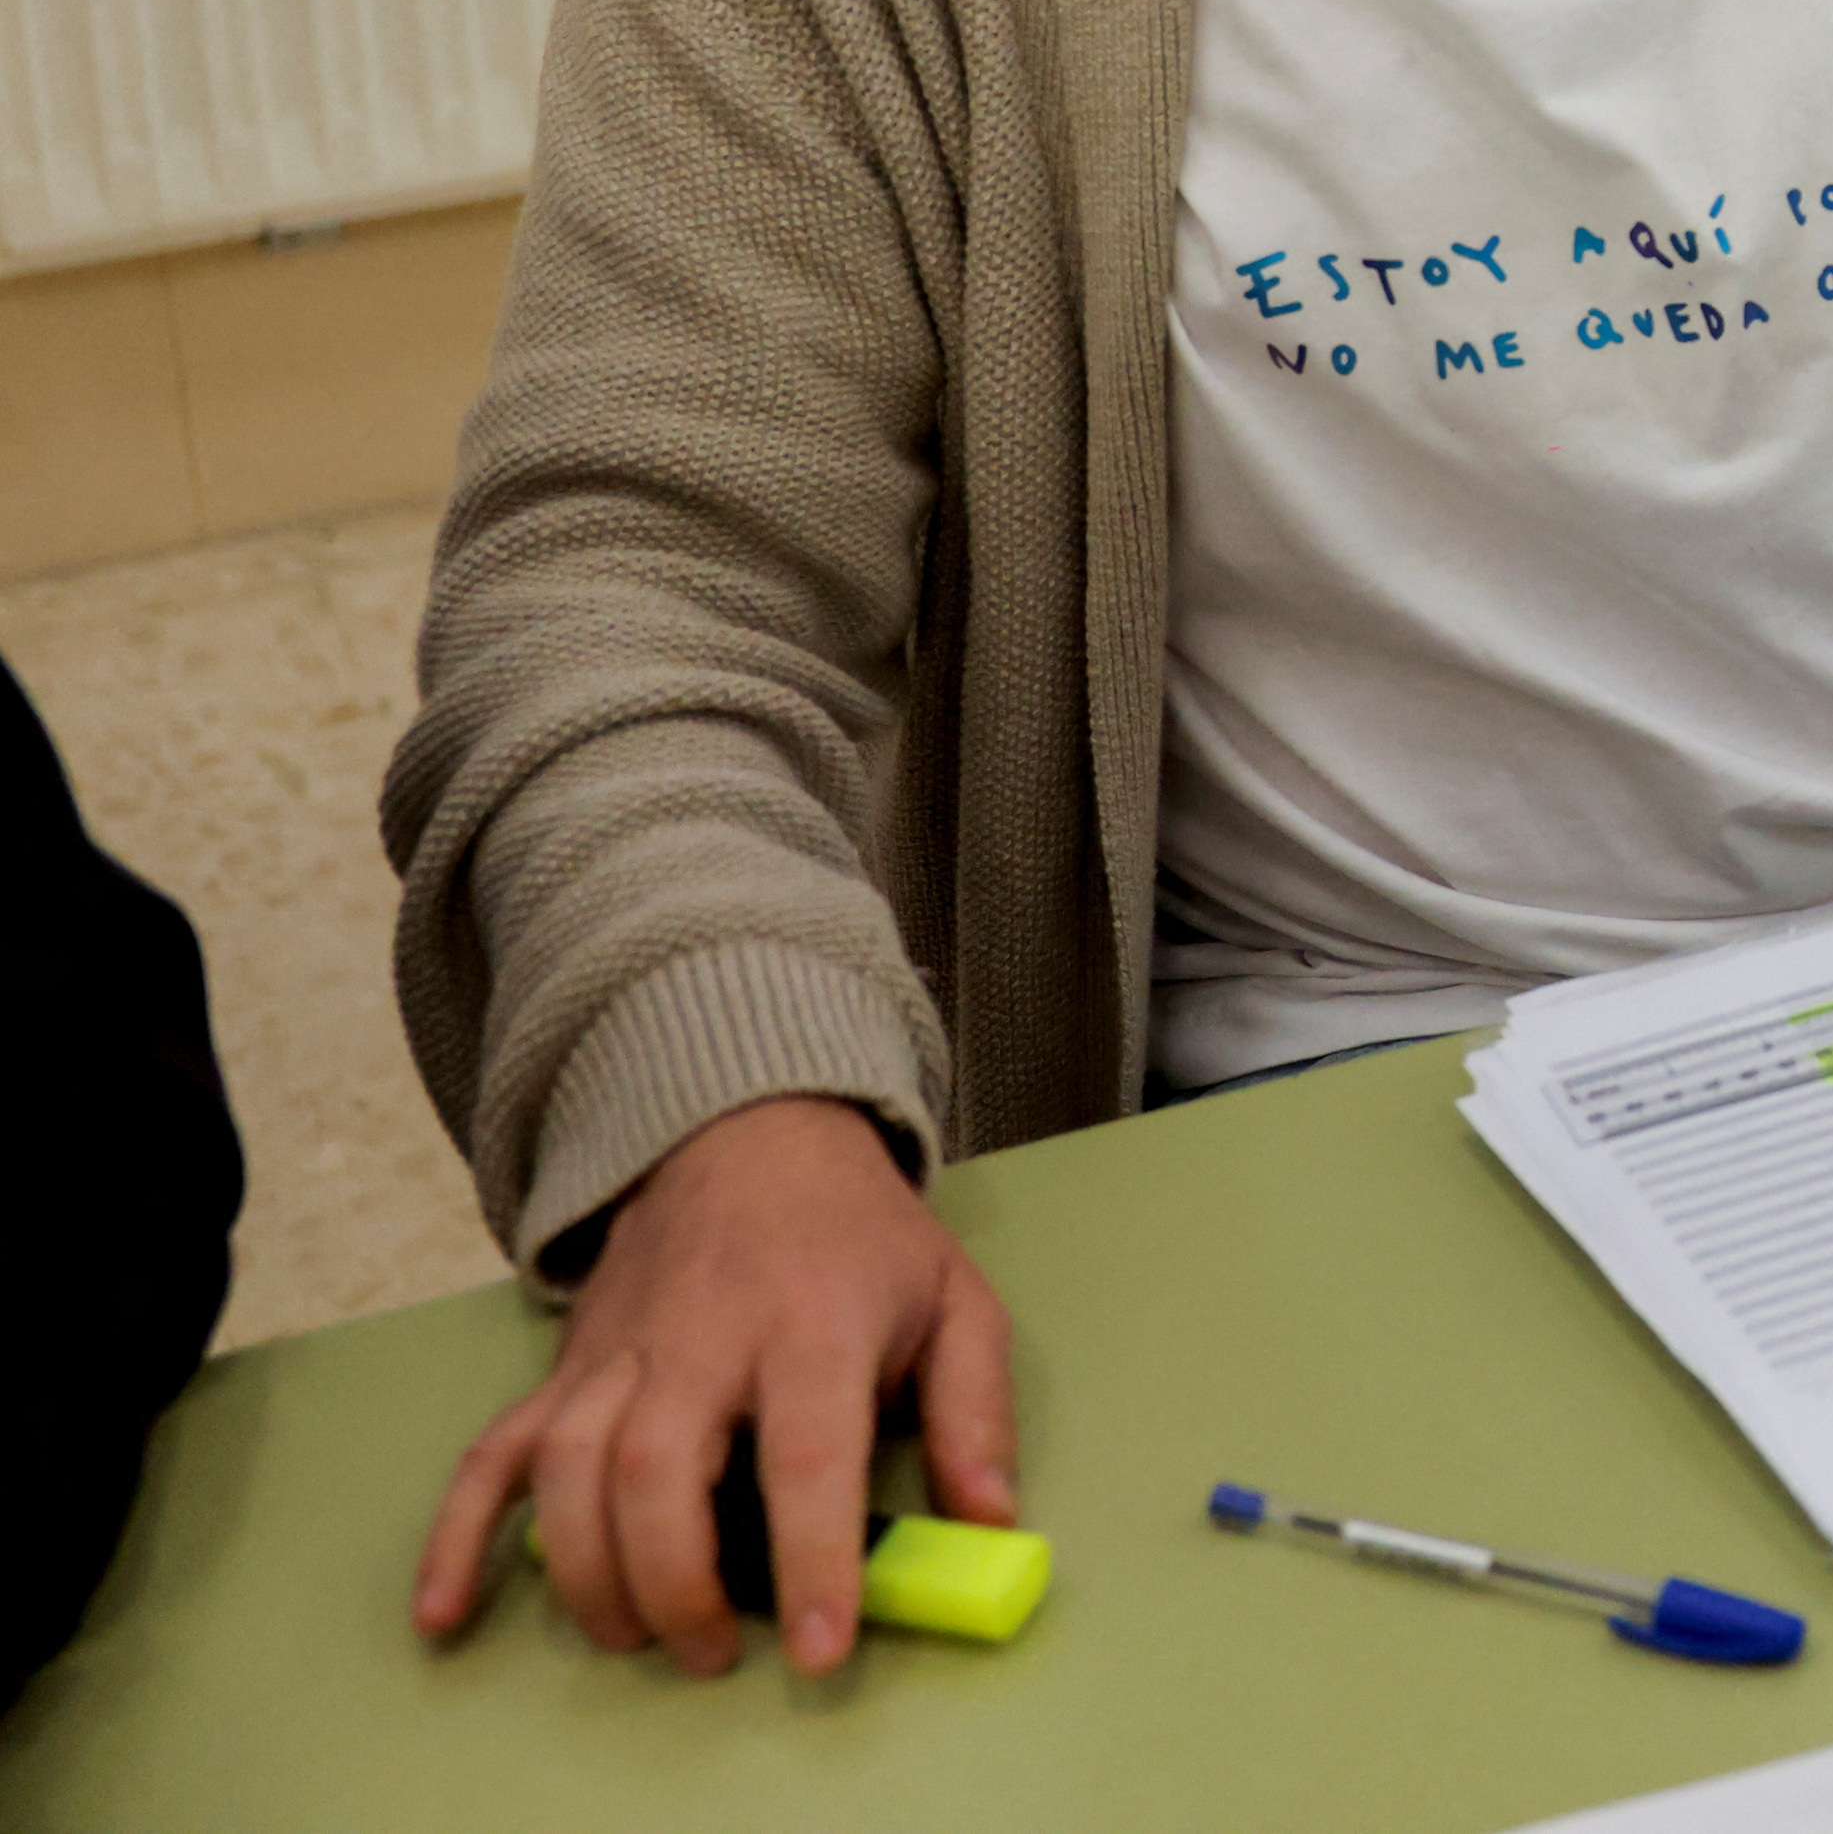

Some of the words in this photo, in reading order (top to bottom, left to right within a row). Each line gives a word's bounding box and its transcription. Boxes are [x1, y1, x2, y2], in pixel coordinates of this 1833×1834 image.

[1236, 234, 1507, 319] ESTOY
[1572, 193, 1732, 269] AQUÍ
[1265, 343, 1357, 375] NO
[1434, 330, 1526, 380] ME
[1576, 300, 1771, 350] QUEDA
